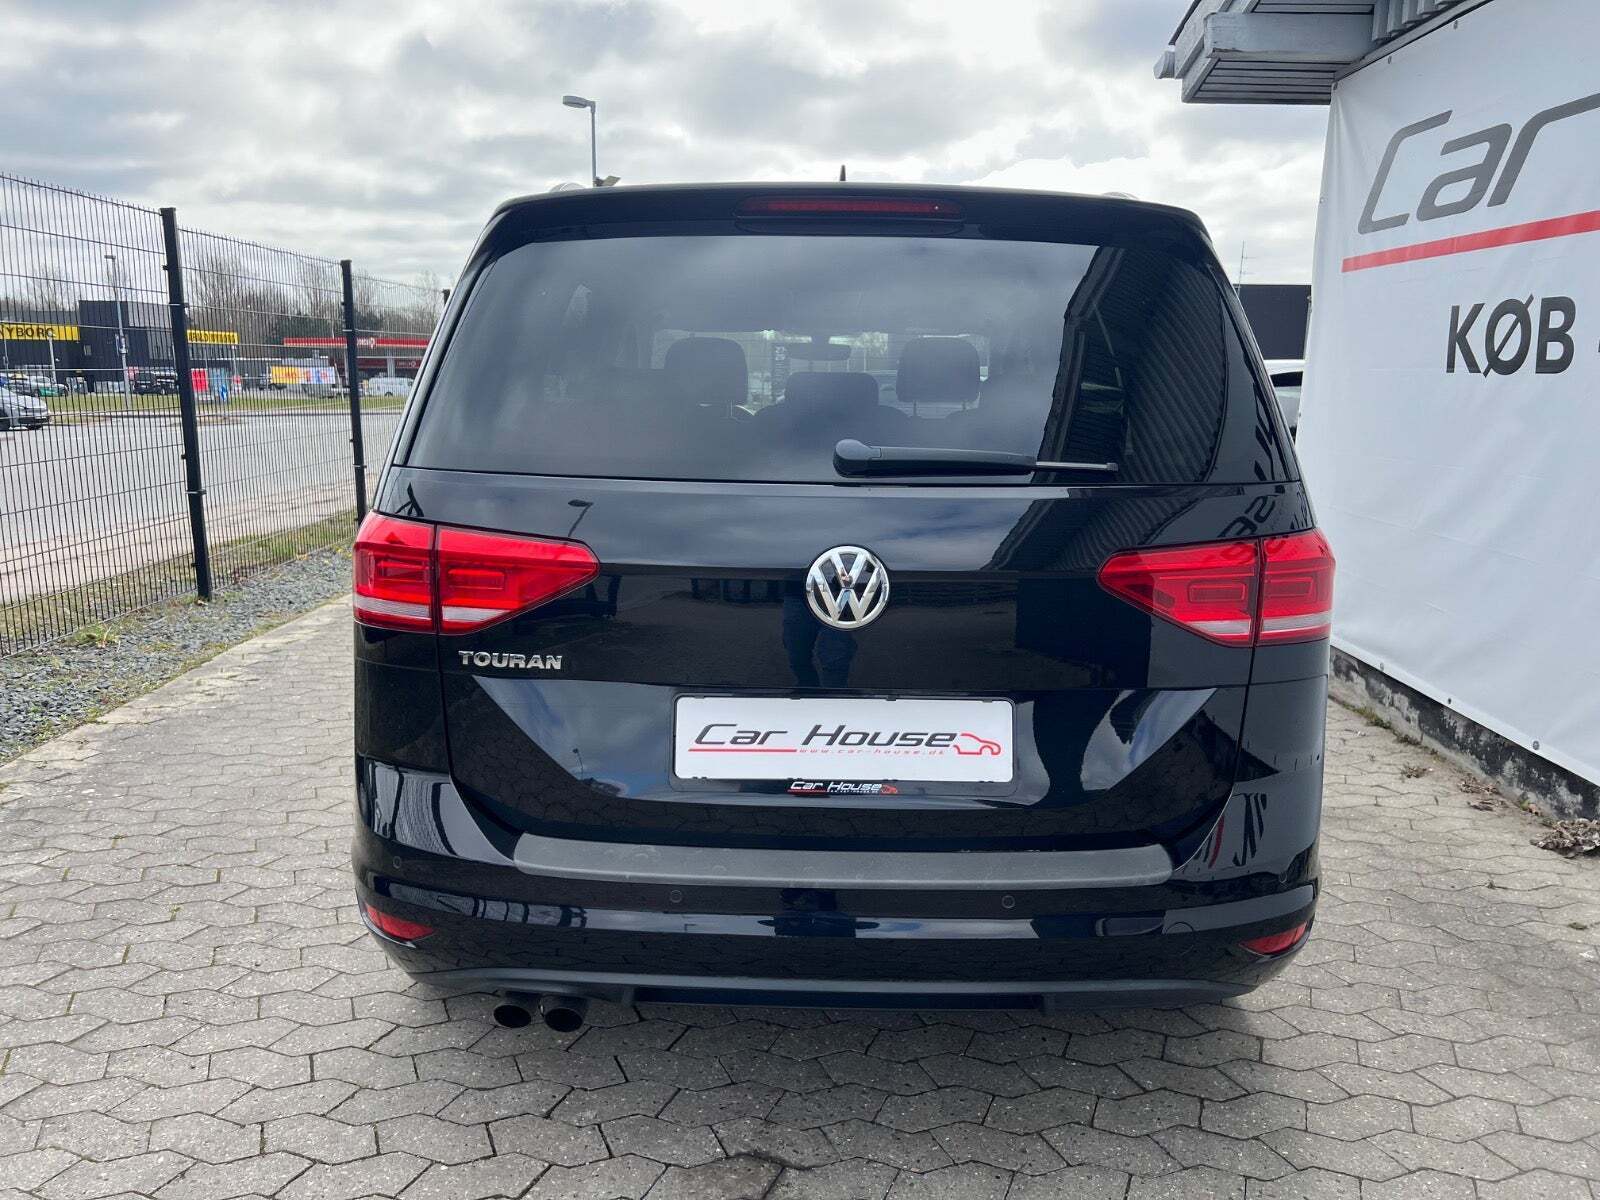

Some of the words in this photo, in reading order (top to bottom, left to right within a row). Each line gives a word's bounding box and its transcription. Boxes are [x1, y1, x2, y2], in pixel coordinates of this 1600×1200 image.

[1358, 92, 1600, 235] Car
[1446, 293, 1577, 378] KØB
[458, 650, 563, 670] TOURAN
[694, 723, 788, 745] Car
[801, 724, 958, 748] House
[790, 781, 824, 790] Car
[827, 781, 882, 792] House
